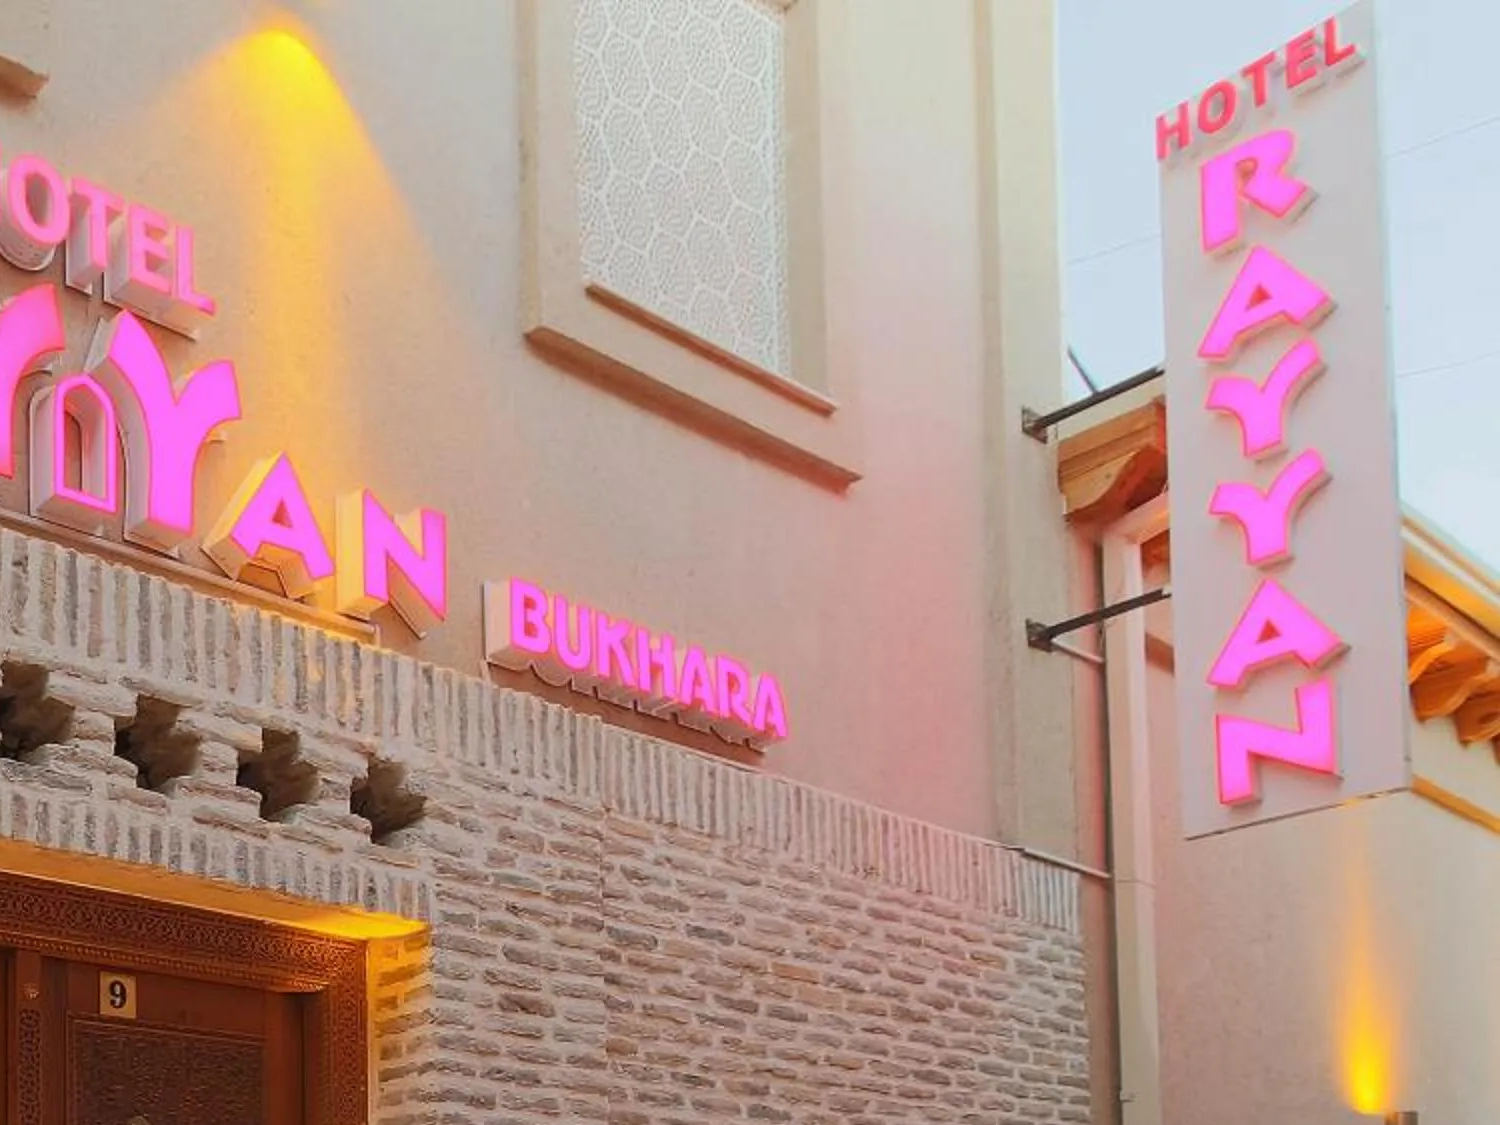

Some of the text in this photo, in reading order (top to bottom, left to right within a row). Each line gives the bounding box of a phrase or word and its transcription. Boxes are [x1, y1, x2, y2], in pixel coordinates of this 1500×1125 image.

[1156, 17, 1358, 162] HOTEL
[1198, 128, 1340, 805] RAYYAN
[509, 576, 790, 738] BUKHARA
[109, 980, 127, 1009] 9
